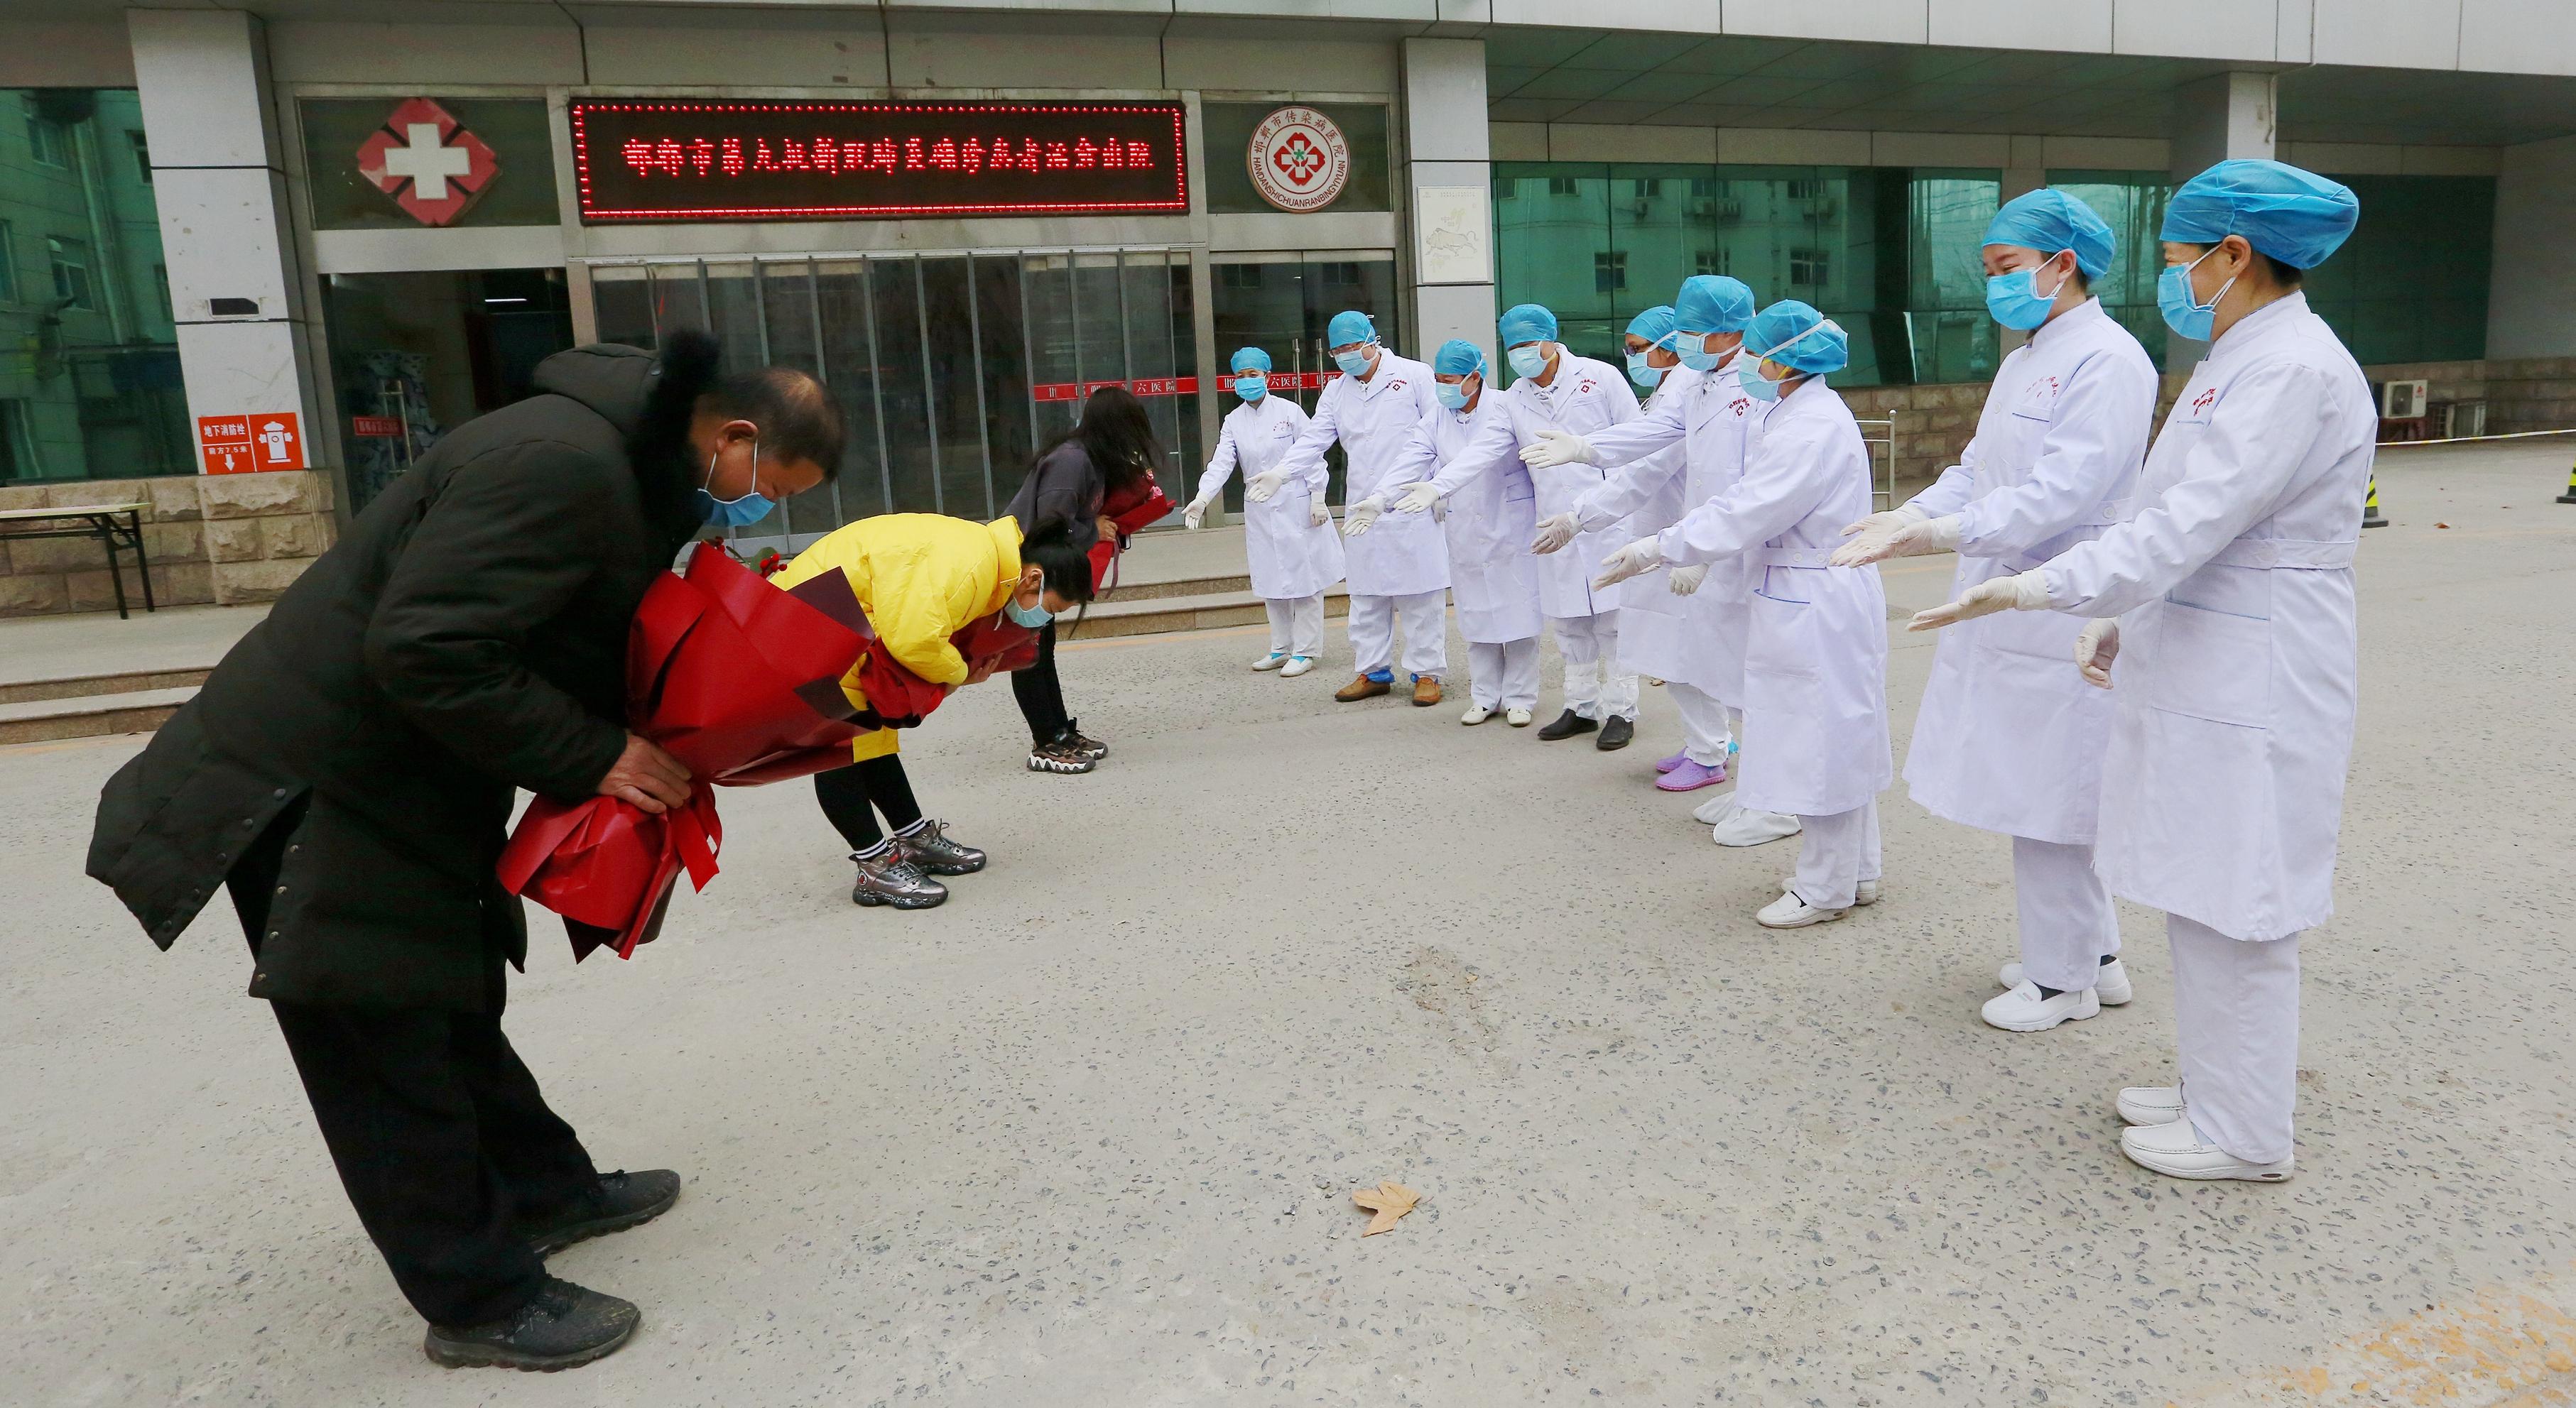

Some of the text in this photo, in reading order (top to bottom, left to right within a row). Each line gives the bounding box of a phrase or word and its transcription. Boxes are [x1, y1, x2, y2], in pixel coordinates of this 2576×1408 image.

[1254, 111, 1344, 158] 邯郸市传染病医院
[1253, 157, 1347, 207] HANDANSHICHUANRANBINGYIYUAN
[204, 424, 246, 437] 地下消防栓
